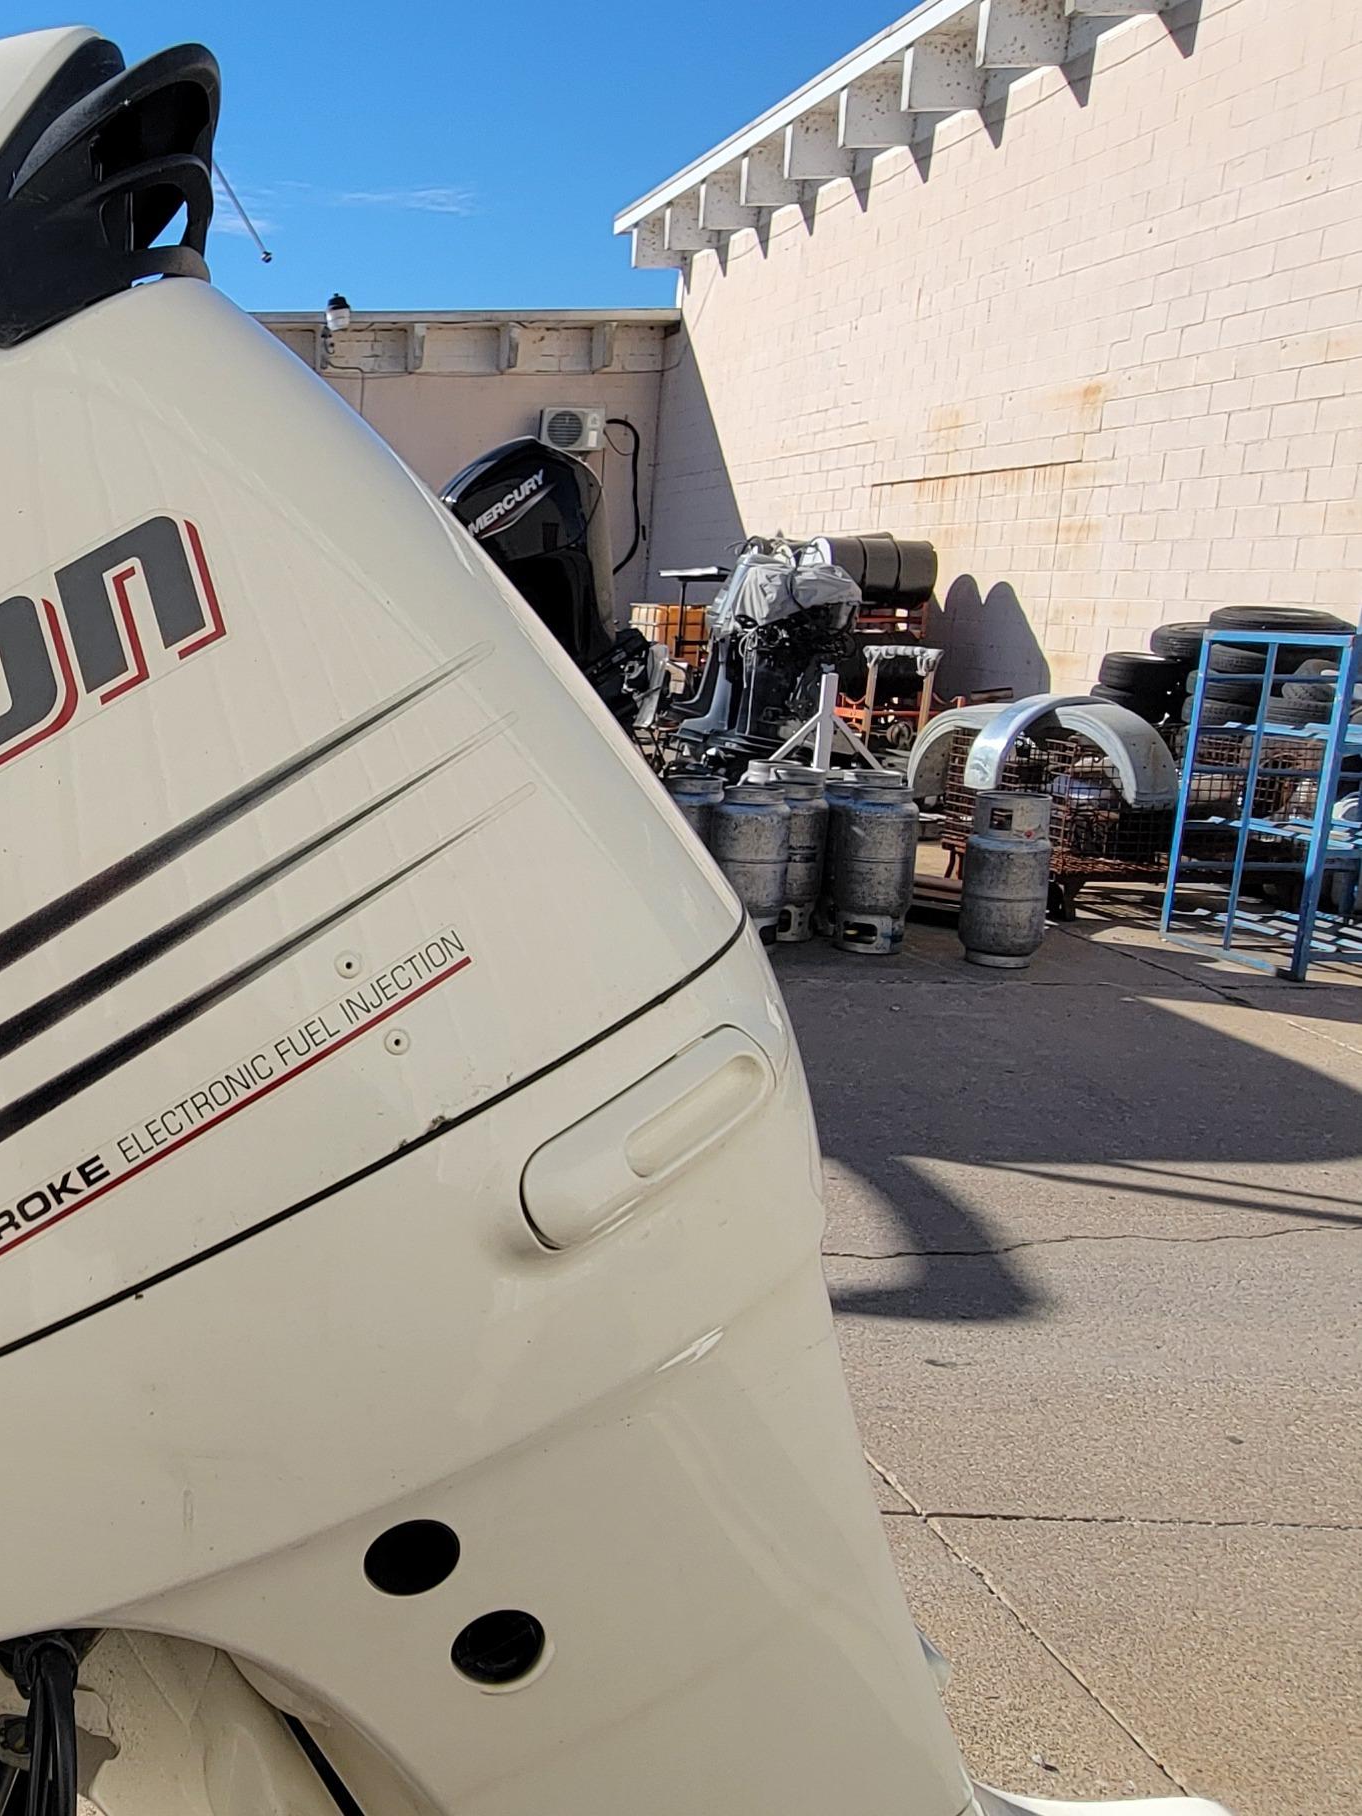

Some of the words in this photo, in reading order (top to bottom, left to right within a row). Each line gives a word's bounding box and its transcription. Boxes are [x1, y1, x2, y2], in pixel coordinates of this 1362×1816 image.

[467, 468, 545, 537] MERCURY
[116, 1053, 274, 1164] ELECTRONIC
[274, 1016, 341, 1066] FUEL
[339, 929, 466, 1025] INJECTION
